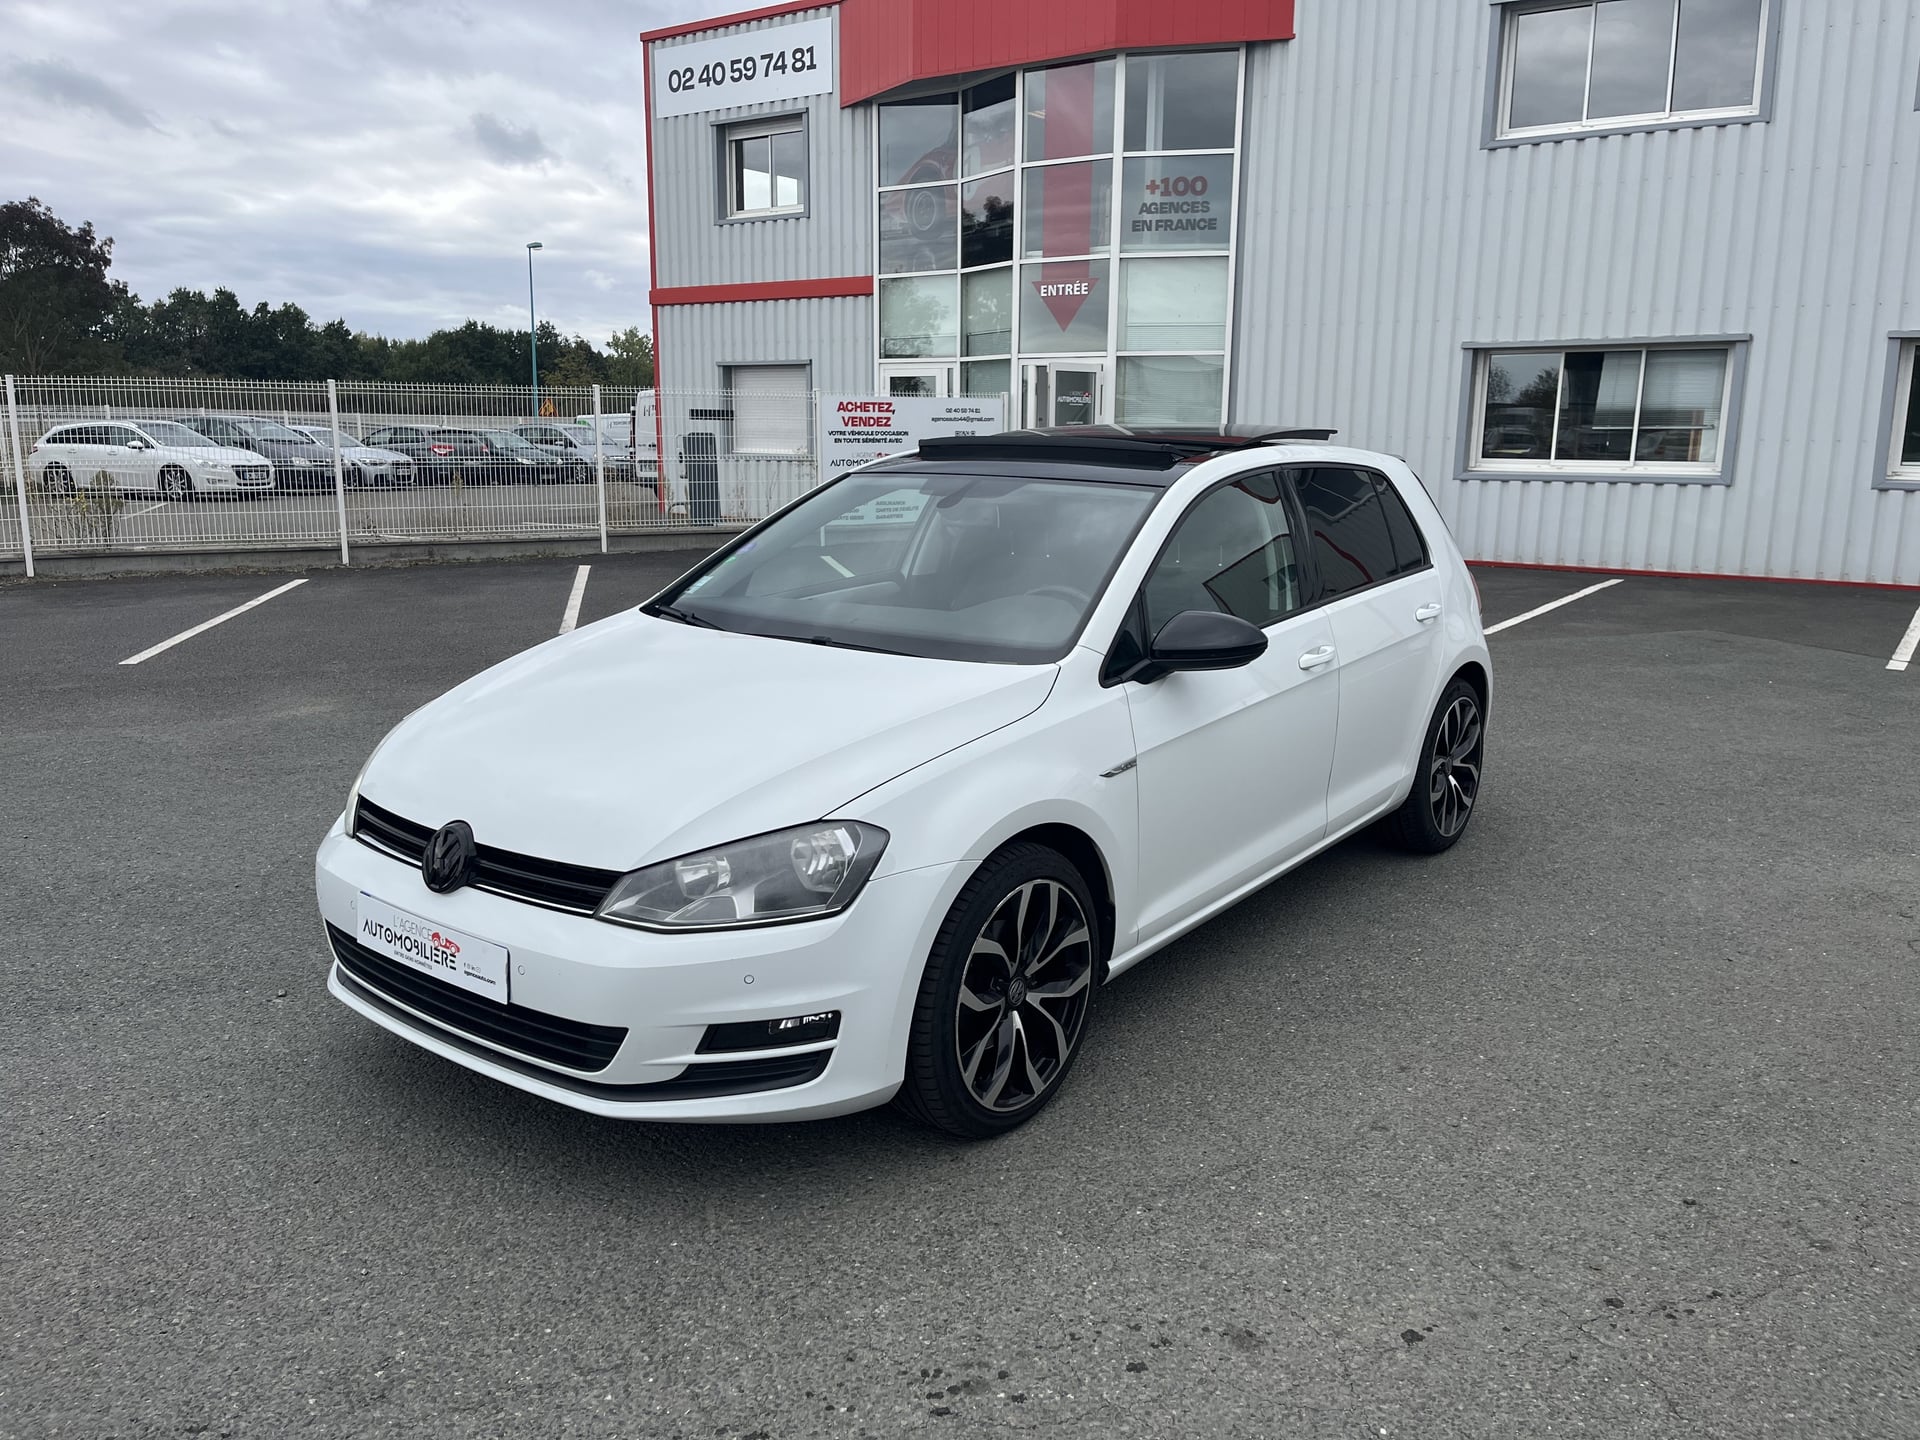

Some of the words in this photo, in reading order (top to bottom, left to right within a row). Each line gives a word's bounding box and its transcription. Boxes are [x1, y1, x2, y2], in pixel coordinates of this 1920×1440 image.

[668, 67, 695, 93] 02
[698, 62, 726, 87] 40
[730, 56, 757, 83] 59
[760, 51, 788, 78] 74
[791, 46, 817, 73] 81
[1145, 176, 1208, 197] +100
[1138, 201, 1211, 215] AGENCES
[1131, 219, 1153, 232] EN
[1155, 218, 1217, 231] FRANCE
[1040, 281, 1089, 297] ENTRÉE
[837, 401, 896, 415] ACHETEZ,
[842, 416, 892, 427] VENDEZ
[393, 915, 432, 941] L'AGENCE
